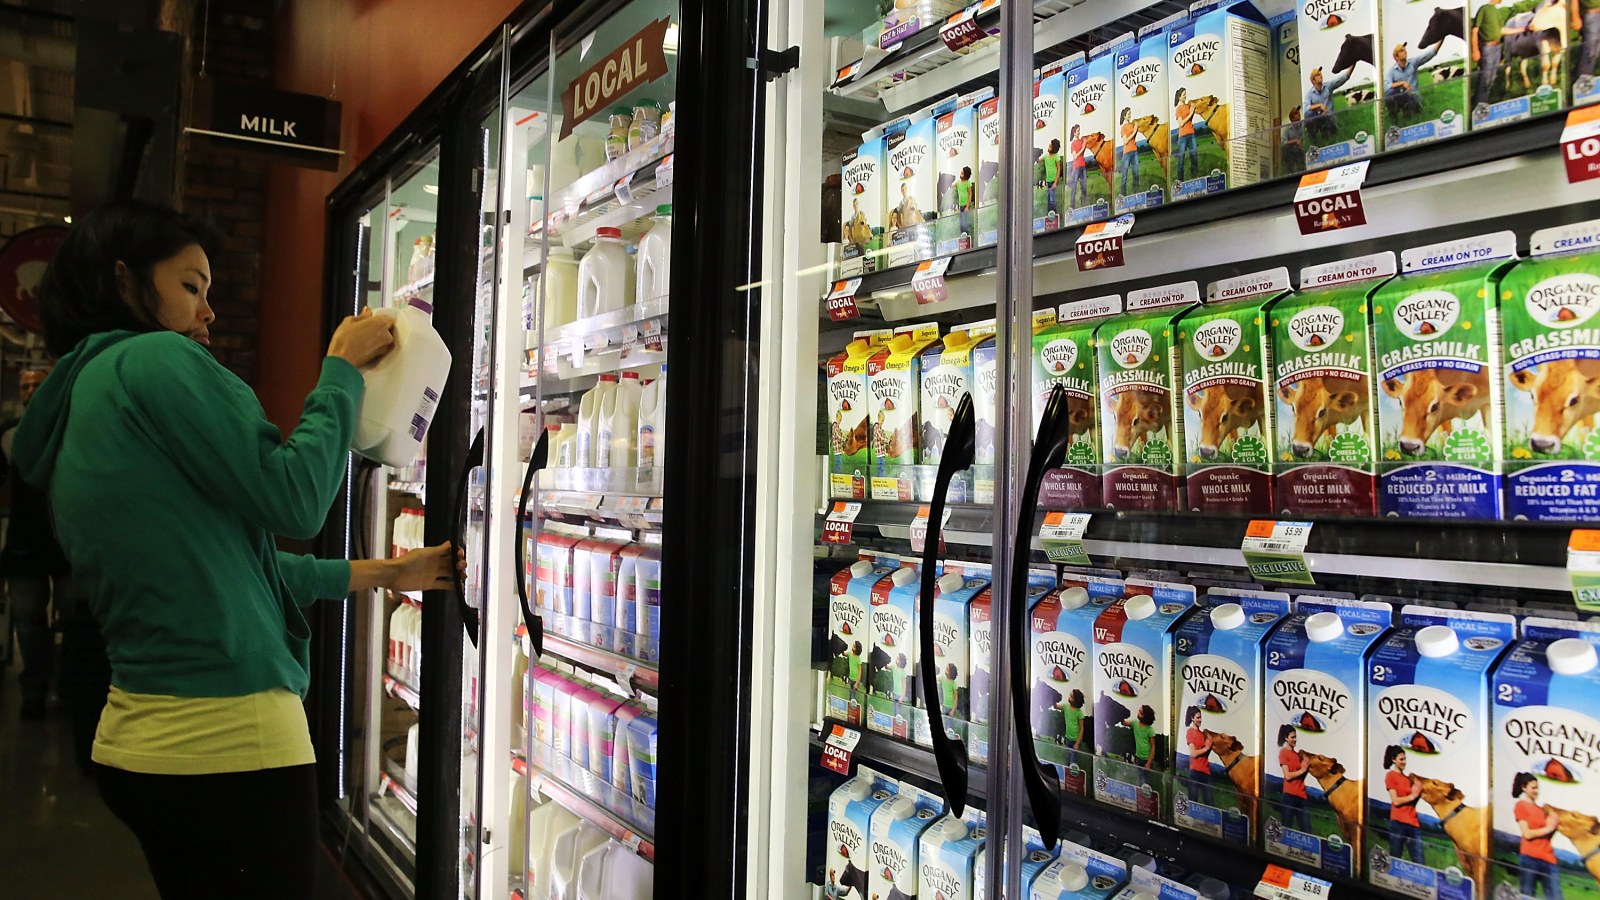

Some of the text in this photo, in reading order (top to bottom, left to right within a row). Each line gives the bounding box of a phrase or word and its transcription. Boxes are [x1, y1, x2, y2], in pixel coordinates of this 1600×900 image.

[1311, 0, 1355, 22] VALLEY
[942, 20, 976, 42] LOCAL
[1174, 41, 1220, 64] ORGANIC
[1178, 52, 1215, 70] VALLEY
[574, 38, 648, 119] LOCAL
[1120, 63, 1161, 85] ORGANIC
[1125, 73, 1156, 91] VALLEY
[1071, 83, 1107, 103] ORGANIC
[1074, 92, 1103, 108] VALLEY
[240, 114, 297, 138] MILK
[1404, 125, 1429, 136] LOCAL
[888, 134, 905, 145] Chocolate
[939, 130, 968, 148] ORGANIC
[942, 138, 964, 152] VALLEY
[890, 144, 927, 166] ORGANIC
[1322, 145, 1345, 156] LOCAL
[894, 155, 923, 172] VALLEY
[1341, 166, 1360, 177] $2.99
[844, 162, 876, 182] ORGANIC
[848, 172, 872, 188] VALLEY
[1184, 180, 1201, 188] LOCAL
[1298, 194, 1358, 217] LOCAL
[1078, 239, 1119, 256] LOCAL
[1554, 236, 1593, 249] CREAM
[1422, 248, 1492, 266] CREAM ON TOP
[1317, 267, 1377, 283] CREAM ON TOP
[913, 279, 943, 292] LOCAL
[1221, 282, 1273, 298] CREAM ON TOP
[1530, 283, 1600, 303] ORGANIC
[828, 297, 854, 309] LOCAL
[1140, 296, 1161, 306] CREAM
[1161, 295, 1171, 303] ON
[1397, 299, 1455, 318] ORGANIC
[1538, 295, 1595, 311] VALLEY
[1070, 309, 1089, 318] CREAM
[1403, 312, 1449, 327] VALLEY
[1291, 313, 1341, 331] ORGANIC
[1196, 326, 1239, 342] ORGANIC
[1296, 324, 1335, 338] VALLEY
[645, 336, 660, 344] LOCAL
[1112, 336, 1150, 349] ORGANIC
[1200, 338, 1234, 349] VALLEY
[1042, 345, 1076, 358] ORGANIC
[1116, 345, 1146, 356] VALLEY
[1381, 342, 1481, 369] GRASSMILK
[886, 361, 910, 370] Omega-3
[941, 357, 968, 366] Omega-3
[1046, 354, 1072, 364] VALLEY
[1278, 352, 1362, 377] GRASSMILK
[843, 363, 865, 373] Omega-3
[1185, 362, 1258, 385] GRASSMILK
[1385, 360, 1480, 380] 100% GRASS-FED NO GRAIN
[830, 379, 862, 393] ORGANIC
[870, 378, 906, 393] ORGANIC
[924, 375, 963, 390] ORGANIC
[1103, 370, 1166, 388] GRASSMILK
[1280, 370, 1360, 387] 100% GRASS-FED NO GRAIN
[874, 388, 902, 401] VALLEY
[928, 385, 957, 399] VALLEY
[1149, 387, 1165, 395] GRAIN
[1188, 385, 1200, 395] 100%
[1200, 379, 1226, 389] GRASS-FED
[1239, 379, 1257, 388] GRAIN
[833, 389, 858, 402] VALLEY
[1238, 450, 1260, 458] OMEGA-3
[1122, 472, 1148, 481] Organic
[1209, 473, 1240, 483] Organic
[1302, 473, 1338, 483] Organic
[1391, 475, 1422, 484] Organic
[1519, 474, 1558, 485] Organic
[1044, 482, 1082, 490] WHOLE MILK
[1115, 482, 1158, 492] WHOLE MILK
[1201, 483, 1252, 494] WHOLE MILK
[1293, 485, 1351, 495] WHOLE MILK
[1388, 483, 1488, 494] REDUCED FAT MILK
[1515, 484, 1598, 496] REDUCED FAT
[826, 522, 850, 533] LOCAL
[1285, 527, 1303, 536] $5.99
[1049, 547, 1083, 558] EXCLUSIVE
[1252, 562, 1306, 573] EXCLUSIVE
[1089, 585, 1105, 593] LOCAL
[832, 602, 865, 620] ORGANIC
[1242, 602, 1262, 610] LOCAL
[1339, 610, 1361, 618] LOCAL
[834, 613, 859, 627] VALLEY
[872, 612, 908, 630] ORGANIC
[1450, 622, 1475, 631] LOCAL
[875, 622, 903, 639] VALLEY
[1036, 640, 1086, 663] ORGANIC
[1040, 653, 1080, 673] VALLEY
[1098, 652, 1155, 677] ORGANIC
[1104, 666, 1149, 688] VALLEY
[1182, 664, 1246, 691] ORGANIC
[1187, 680, 1239, 704] VALLEY
[1273, 679, 1348, 709] ORGANIC
[1280, 695, 1340, 723] VALLEY
[1378, 696, 1468, 729] ORGANIC
[1386, 713, 1457, 742] VALLEY
[824, 744, 848, 762] LOCAL
[1515, 738, 1600, 768] VALLEY
[1192, 804, 1215, 816] LOCAL
[830, 820, 862, 847] ORGANIC
[1285, 832, 1314, 845] LOCAL
[832, 832, 858, 852] VALLEY
[872, 842, 908, 869] ORGANIC
[875, 854, 903, 875] VALLEY
[1394, 862, 1428, 878] LOCAL
[922, 864, 961, 892] ORGANIC
[925, 878, 957, 900] VALLEY
